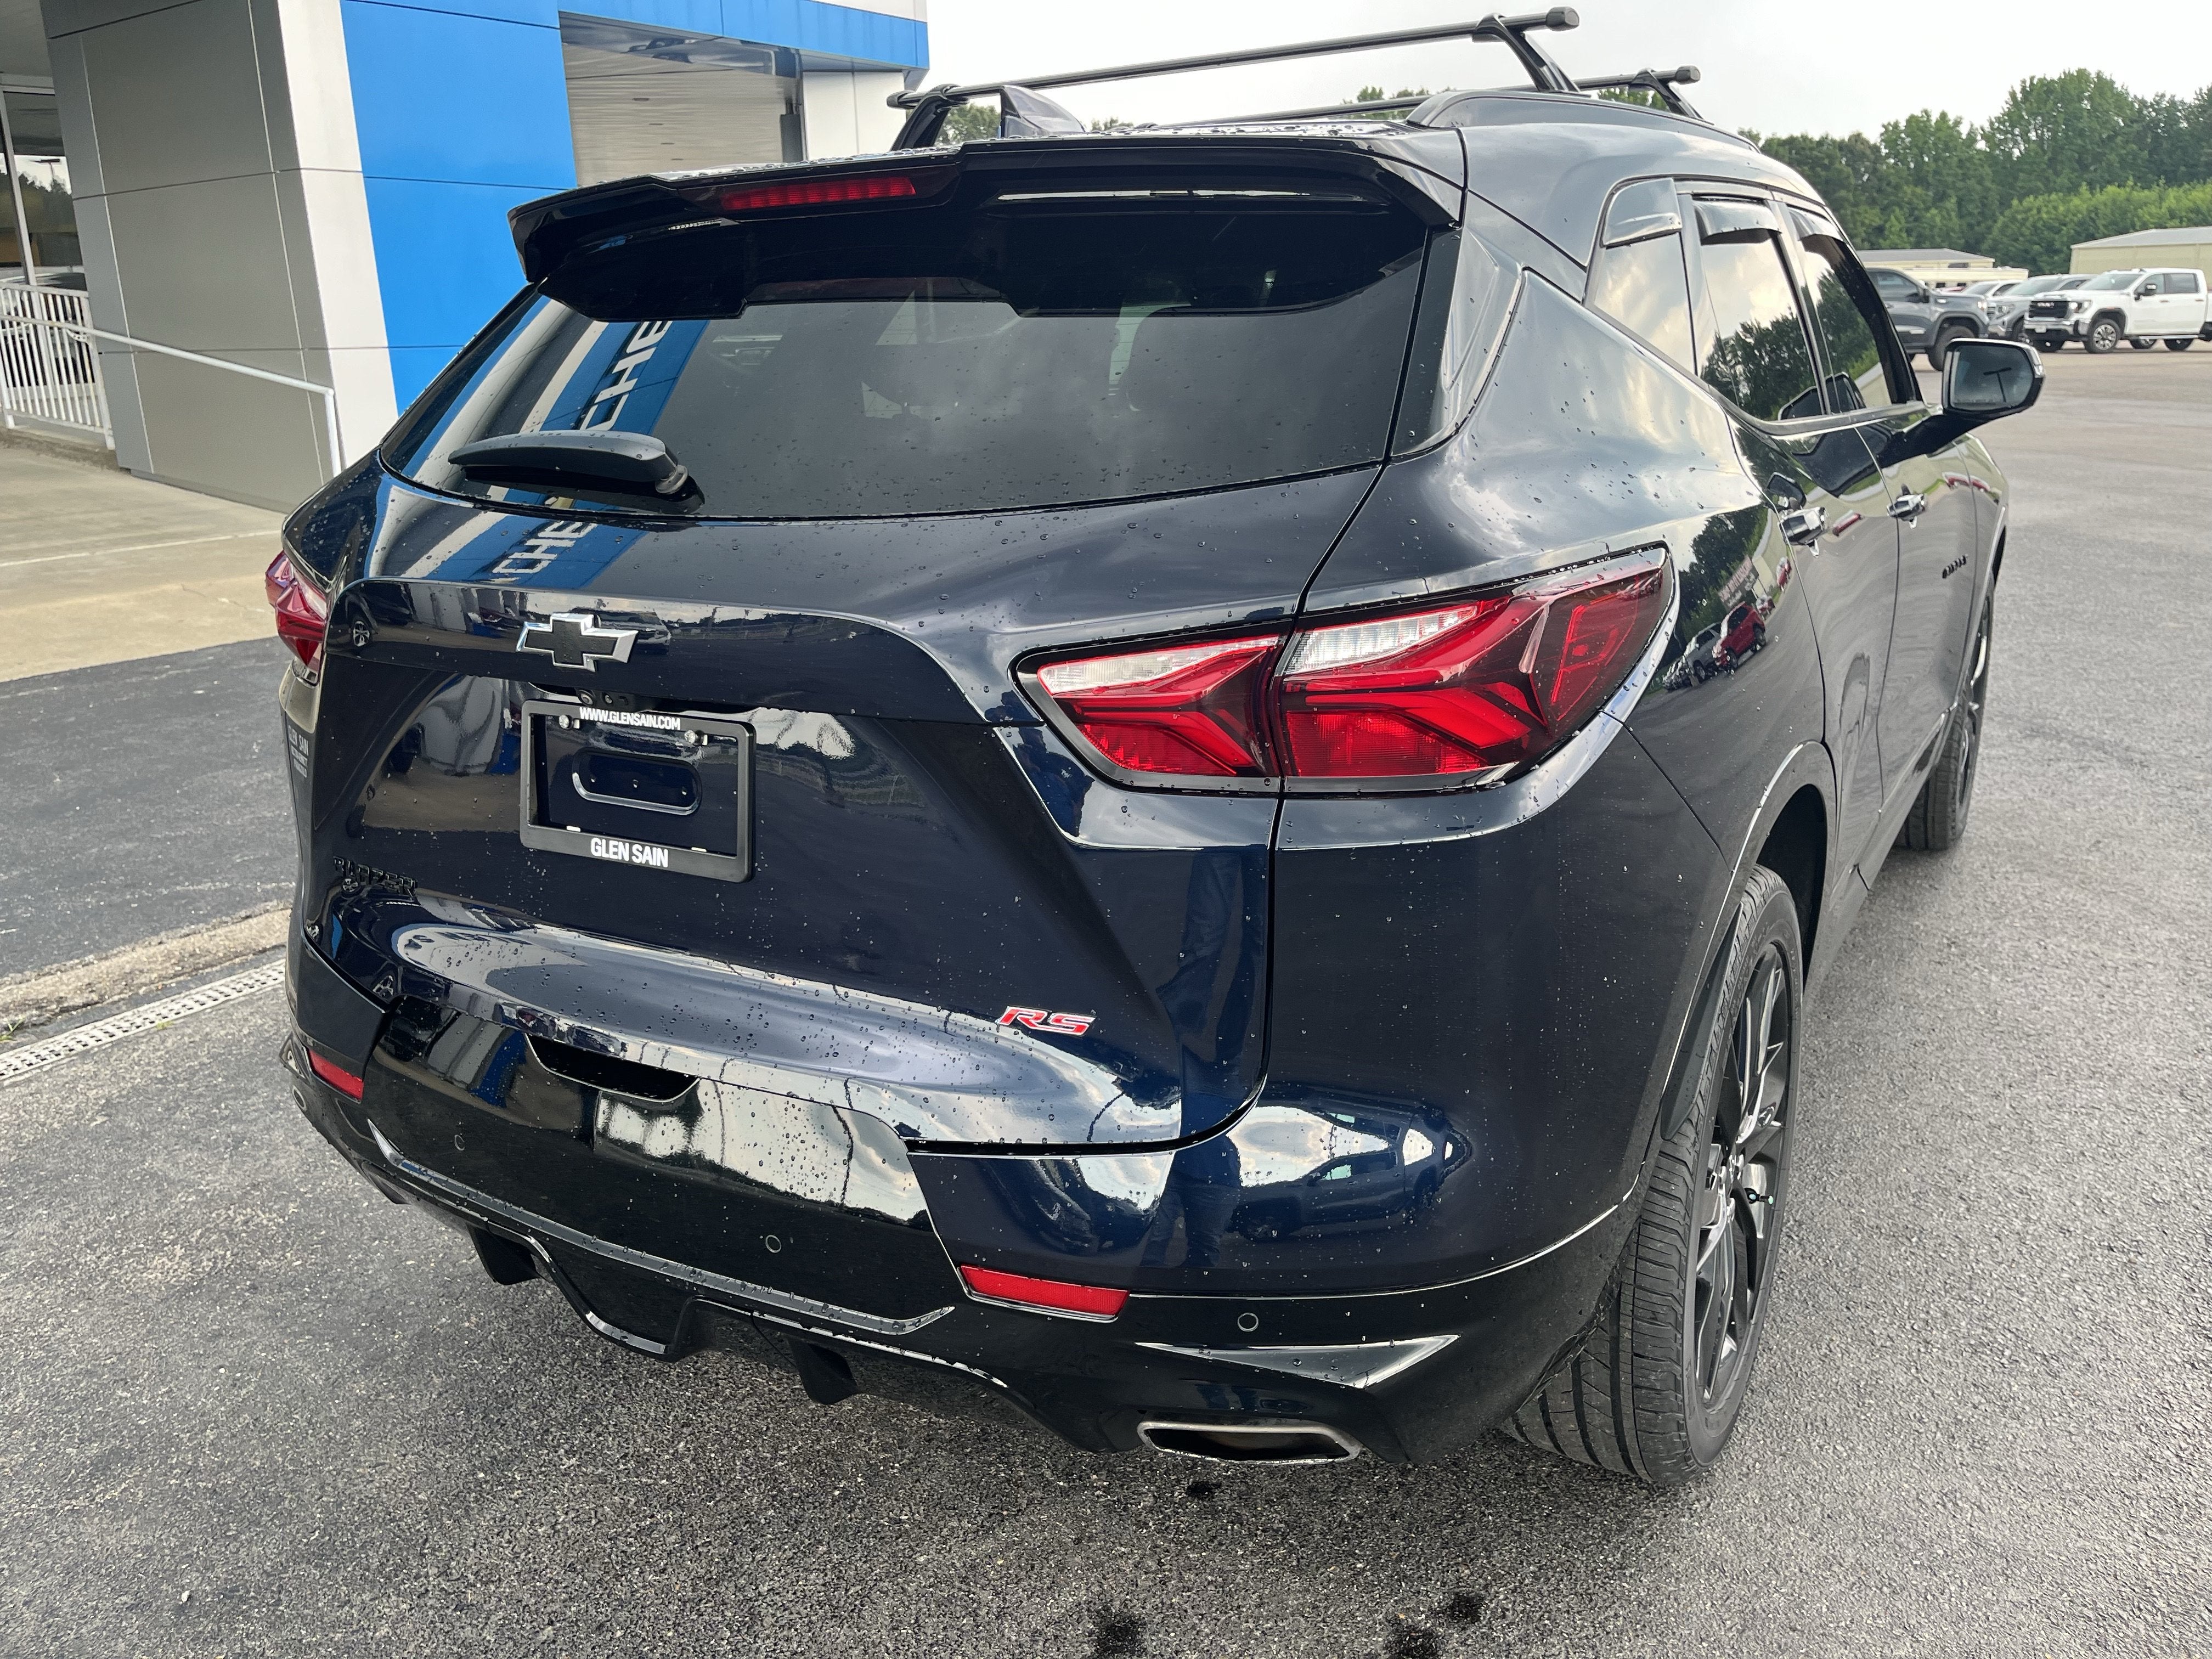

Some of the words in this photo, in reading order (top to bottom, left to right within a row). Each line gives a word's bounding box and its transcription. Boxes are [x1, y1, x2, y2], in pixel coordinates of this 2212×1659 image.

[579, 707, 681, 730] WWW.GLENSAIN.COM
[591, 838, 629, 861] GLEN
[632, 845, 668, 868] SAIN
[995, 1006, 1096, 1036] RS
